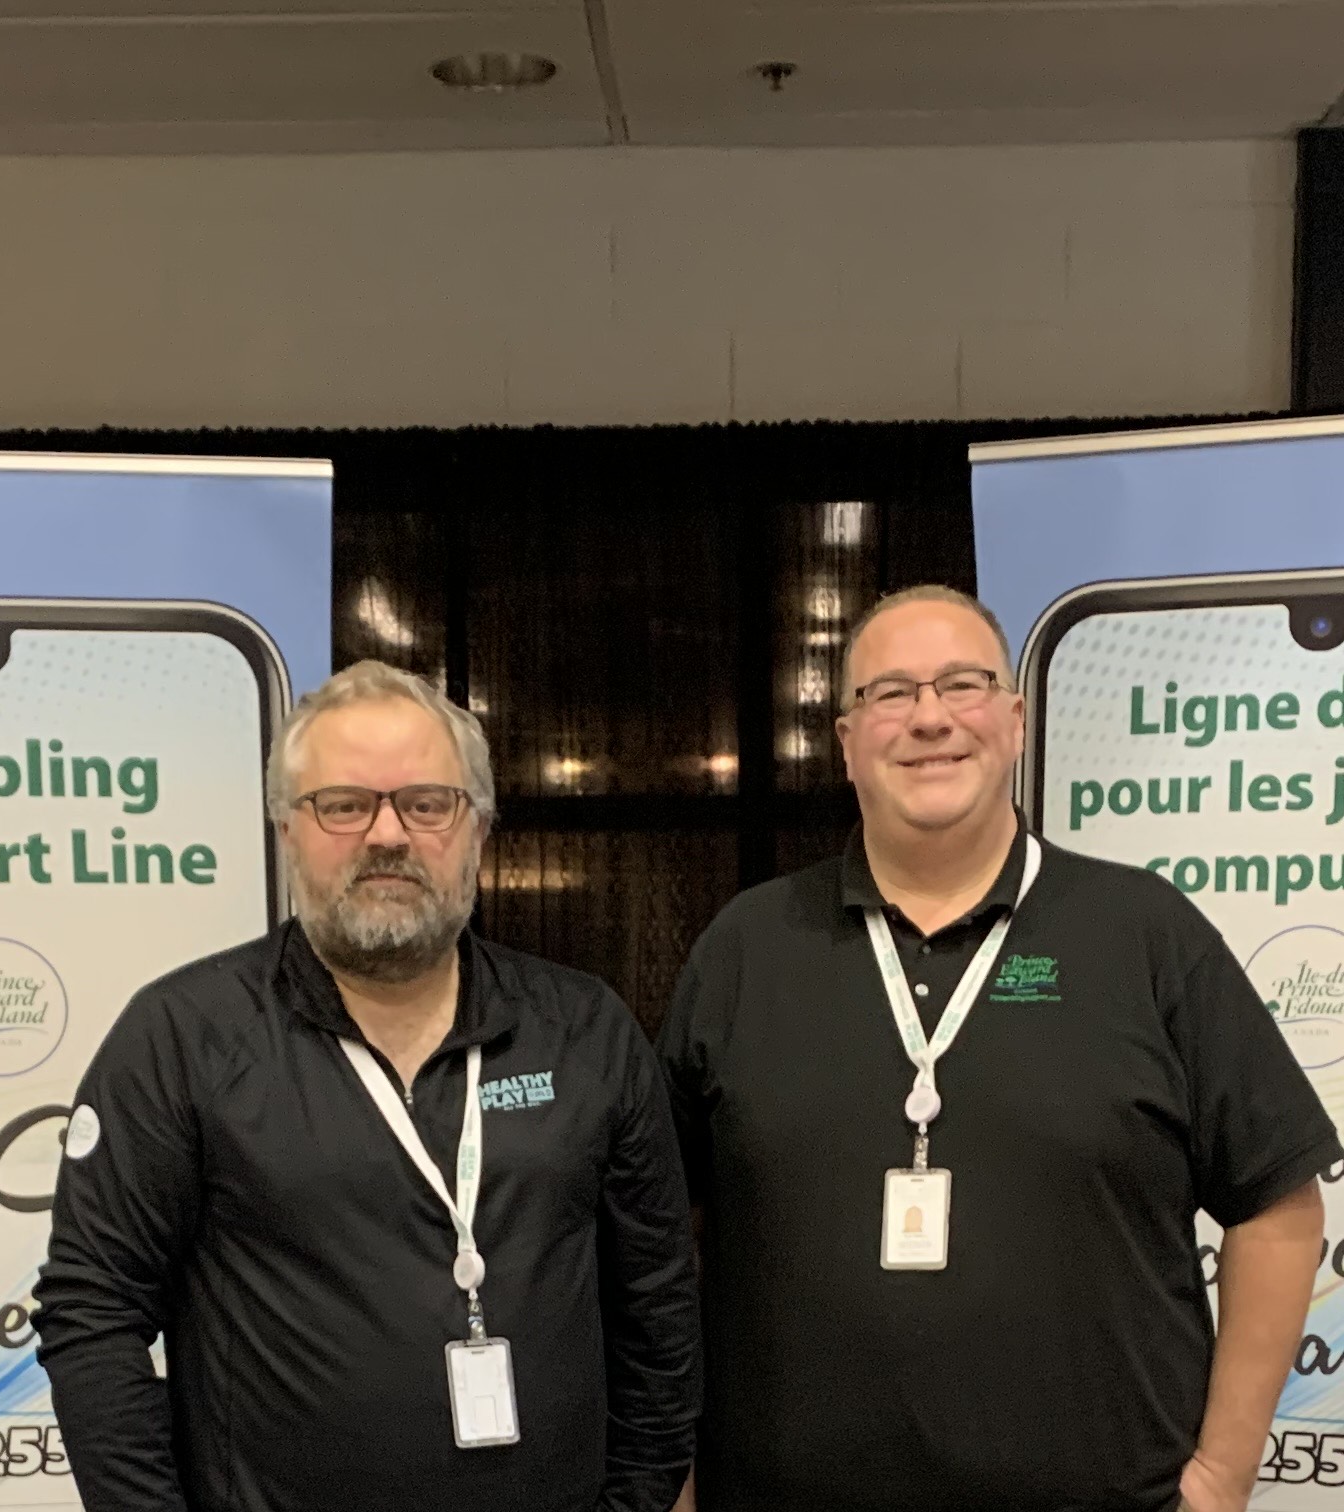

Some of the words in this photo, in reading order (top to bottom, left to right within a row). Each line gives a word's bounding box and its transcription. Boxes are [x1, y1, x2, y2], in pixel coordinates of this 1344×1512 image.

[1129, 680, 1301, 748] Ligne
[1069, 776, 1212, 831] pour
[1228, 759, 1314, 812] les
[73, 827, 217, 885] Line
[478, 1070, 553, 1098] HEALTHY
[481, 1088, 524, 1111] PLAY
